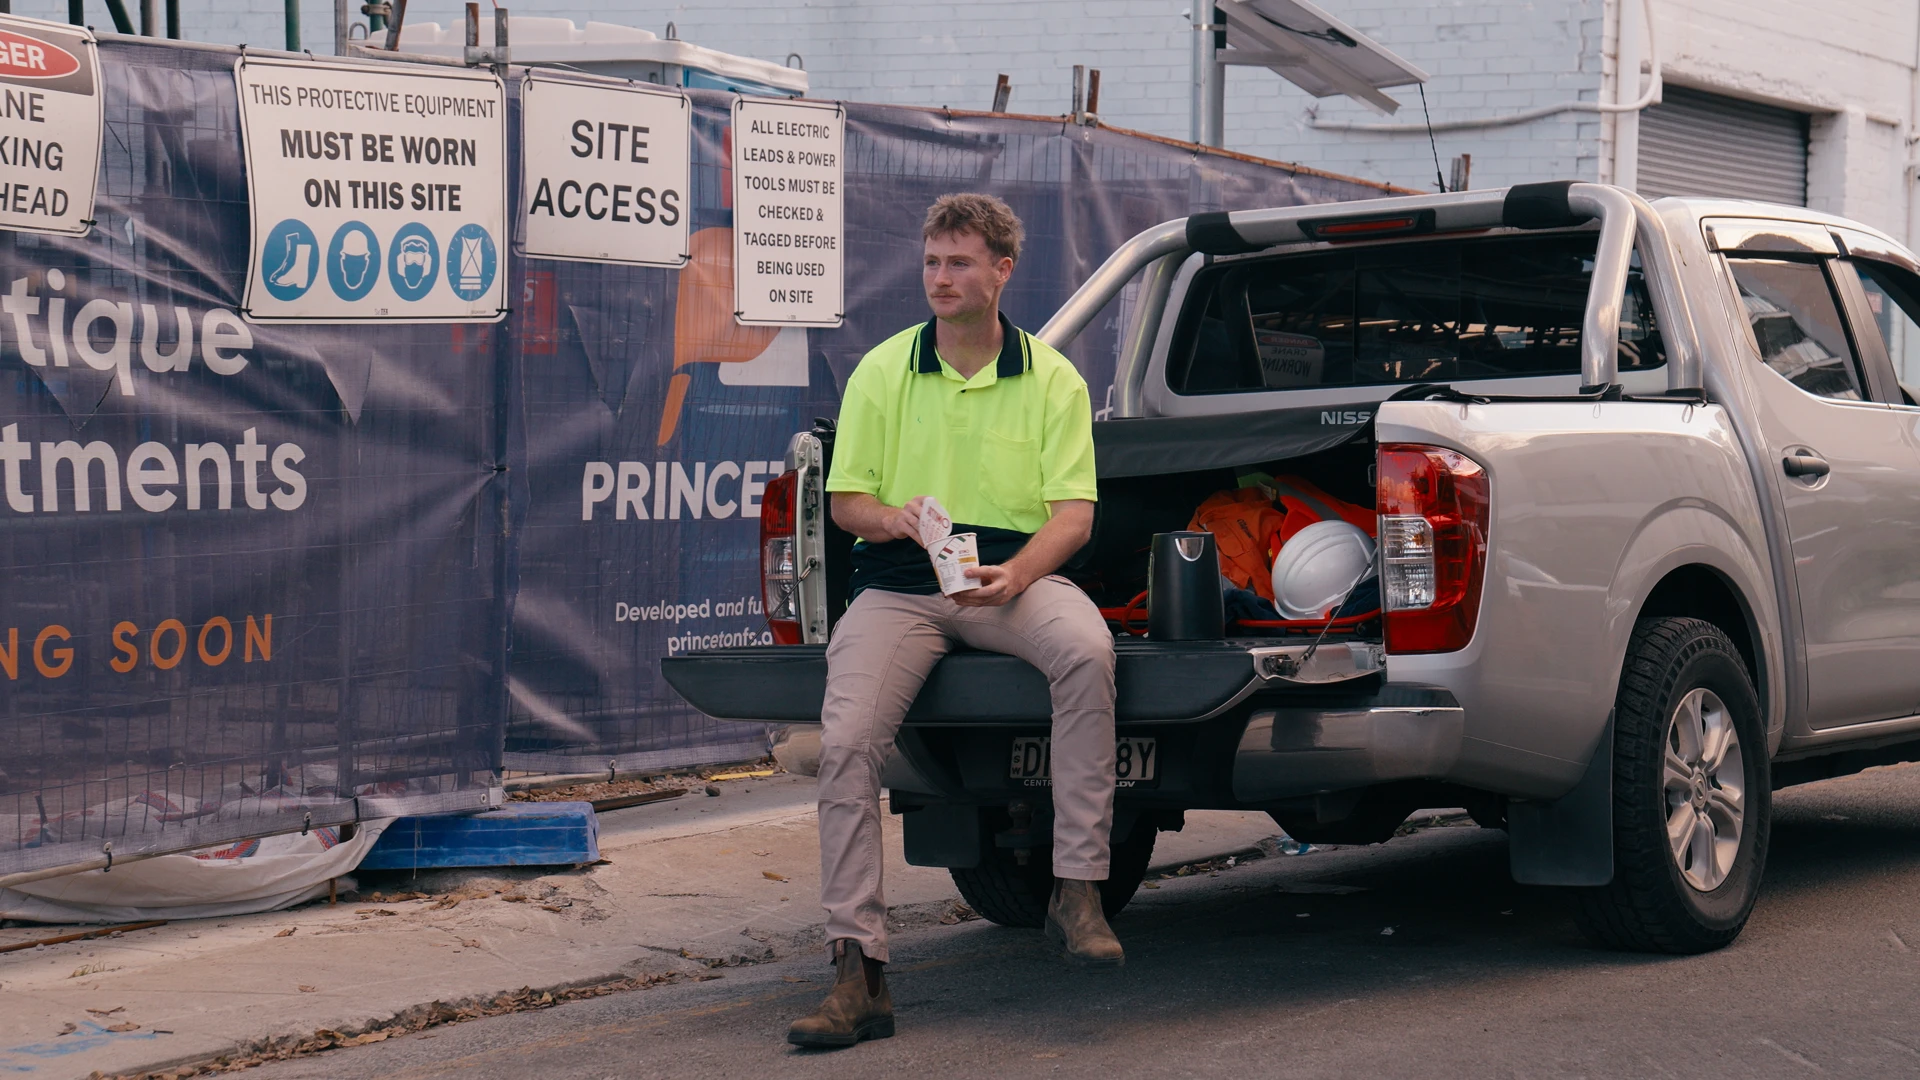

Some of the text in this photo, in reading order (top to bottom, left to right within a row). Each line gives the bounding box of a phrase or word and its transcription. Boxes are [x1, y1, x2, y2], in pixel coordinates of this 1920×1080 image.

[0, 89, 45, 123] NE
[250, 84, 496, 119] THIS PROTECTIVE EQUIPMENT
[571, 119, 650, 164] SITE
[751, 119, 830, 140] ALL ELECTRIC
[280, 129, 476, 167] MUST BE WORN
[744, 148, 836, 168] LEADS & POWER
[304, 178, 462, 212] ON THIS SITE
[744, 175, 835, 195] TOOLS MUST BE
[529, 177, 680, 226] ACCESS
[758, 204, 824, 222] CHECKED &
[744, 231, 836, 250] TAGGED BEFORE
[757, 260, 825, 277] BEING USED
[769, 288, 813, 304] ON SITE
[1, 268, 253, 396] tique
[1321, 411, 1371, 425] NISS
[0, 422, 308, 513] tments
[615, 595, 766, 624] Developed and fu
[110, 614, 273, 673] SOON
